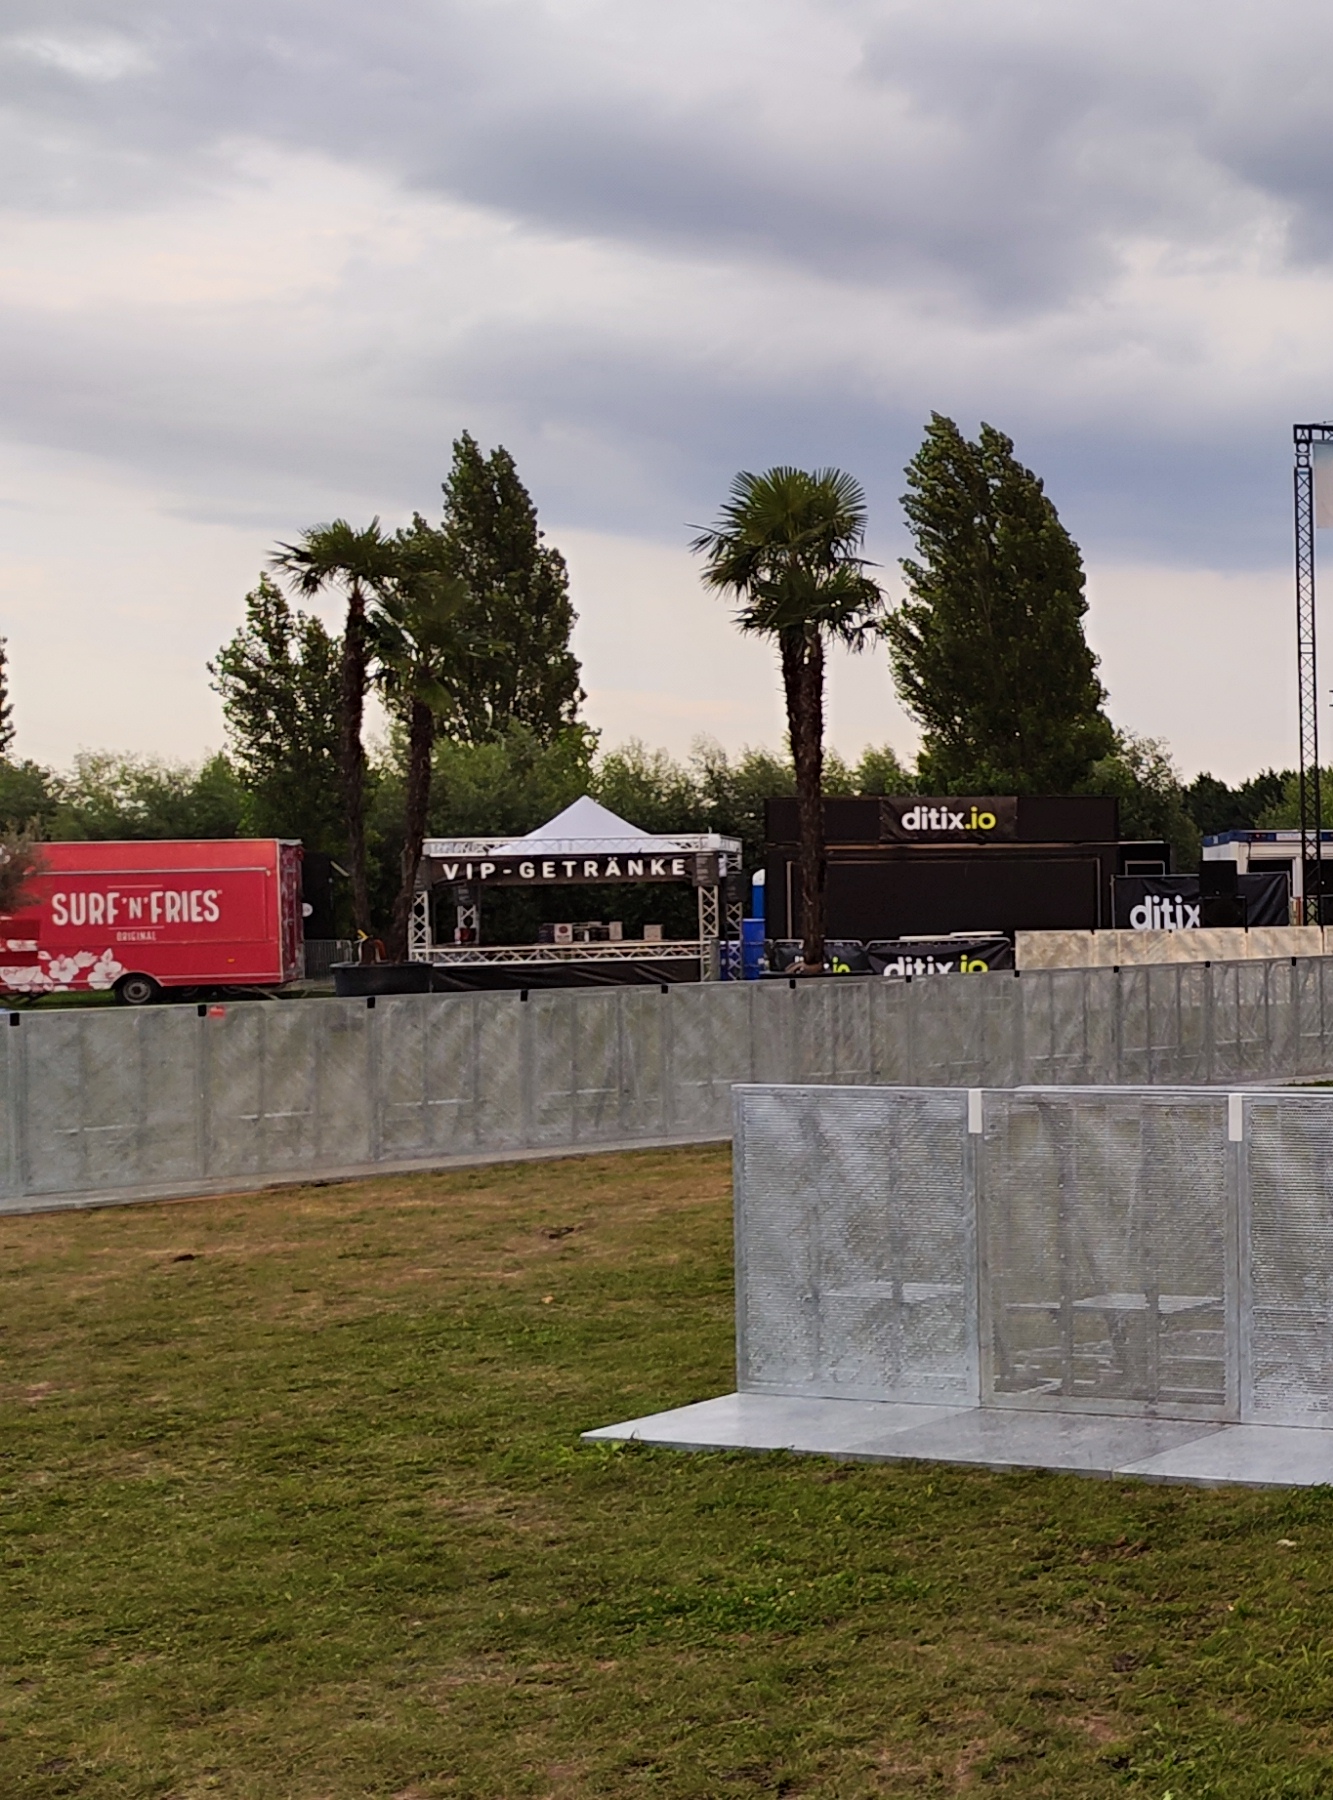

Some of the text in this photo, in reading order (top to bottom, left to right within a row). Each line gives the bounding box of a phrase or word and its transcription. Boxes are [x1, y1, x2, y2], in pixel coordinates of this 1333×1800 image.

[901, 806, 996, 831] ditix.io
[442, 857, 686, 880] VIP-GETRÄNKE
[116, 931, 157, 941] ORIGINAL
